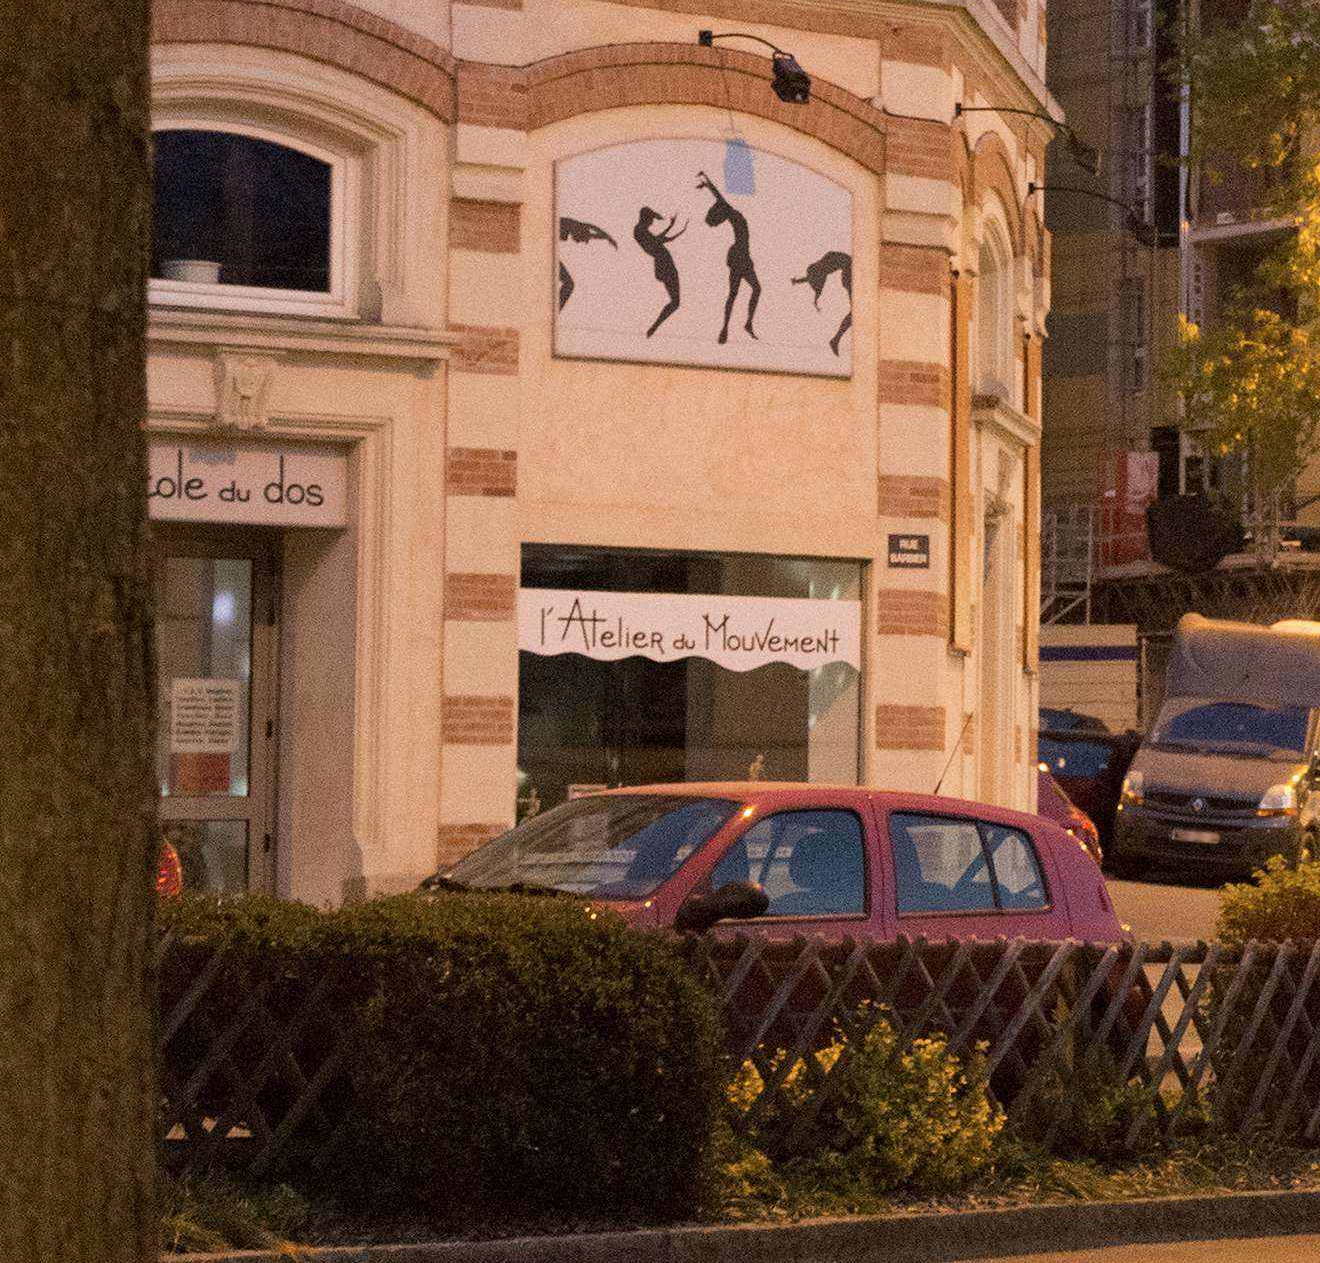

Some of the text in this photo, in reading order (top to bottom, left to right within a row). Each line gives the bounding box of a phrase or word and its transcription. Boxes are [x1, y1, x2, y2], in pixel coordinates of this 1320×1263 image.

[148, 449, 325, 506] ole du dos
[672, 630, 696, 649] du
